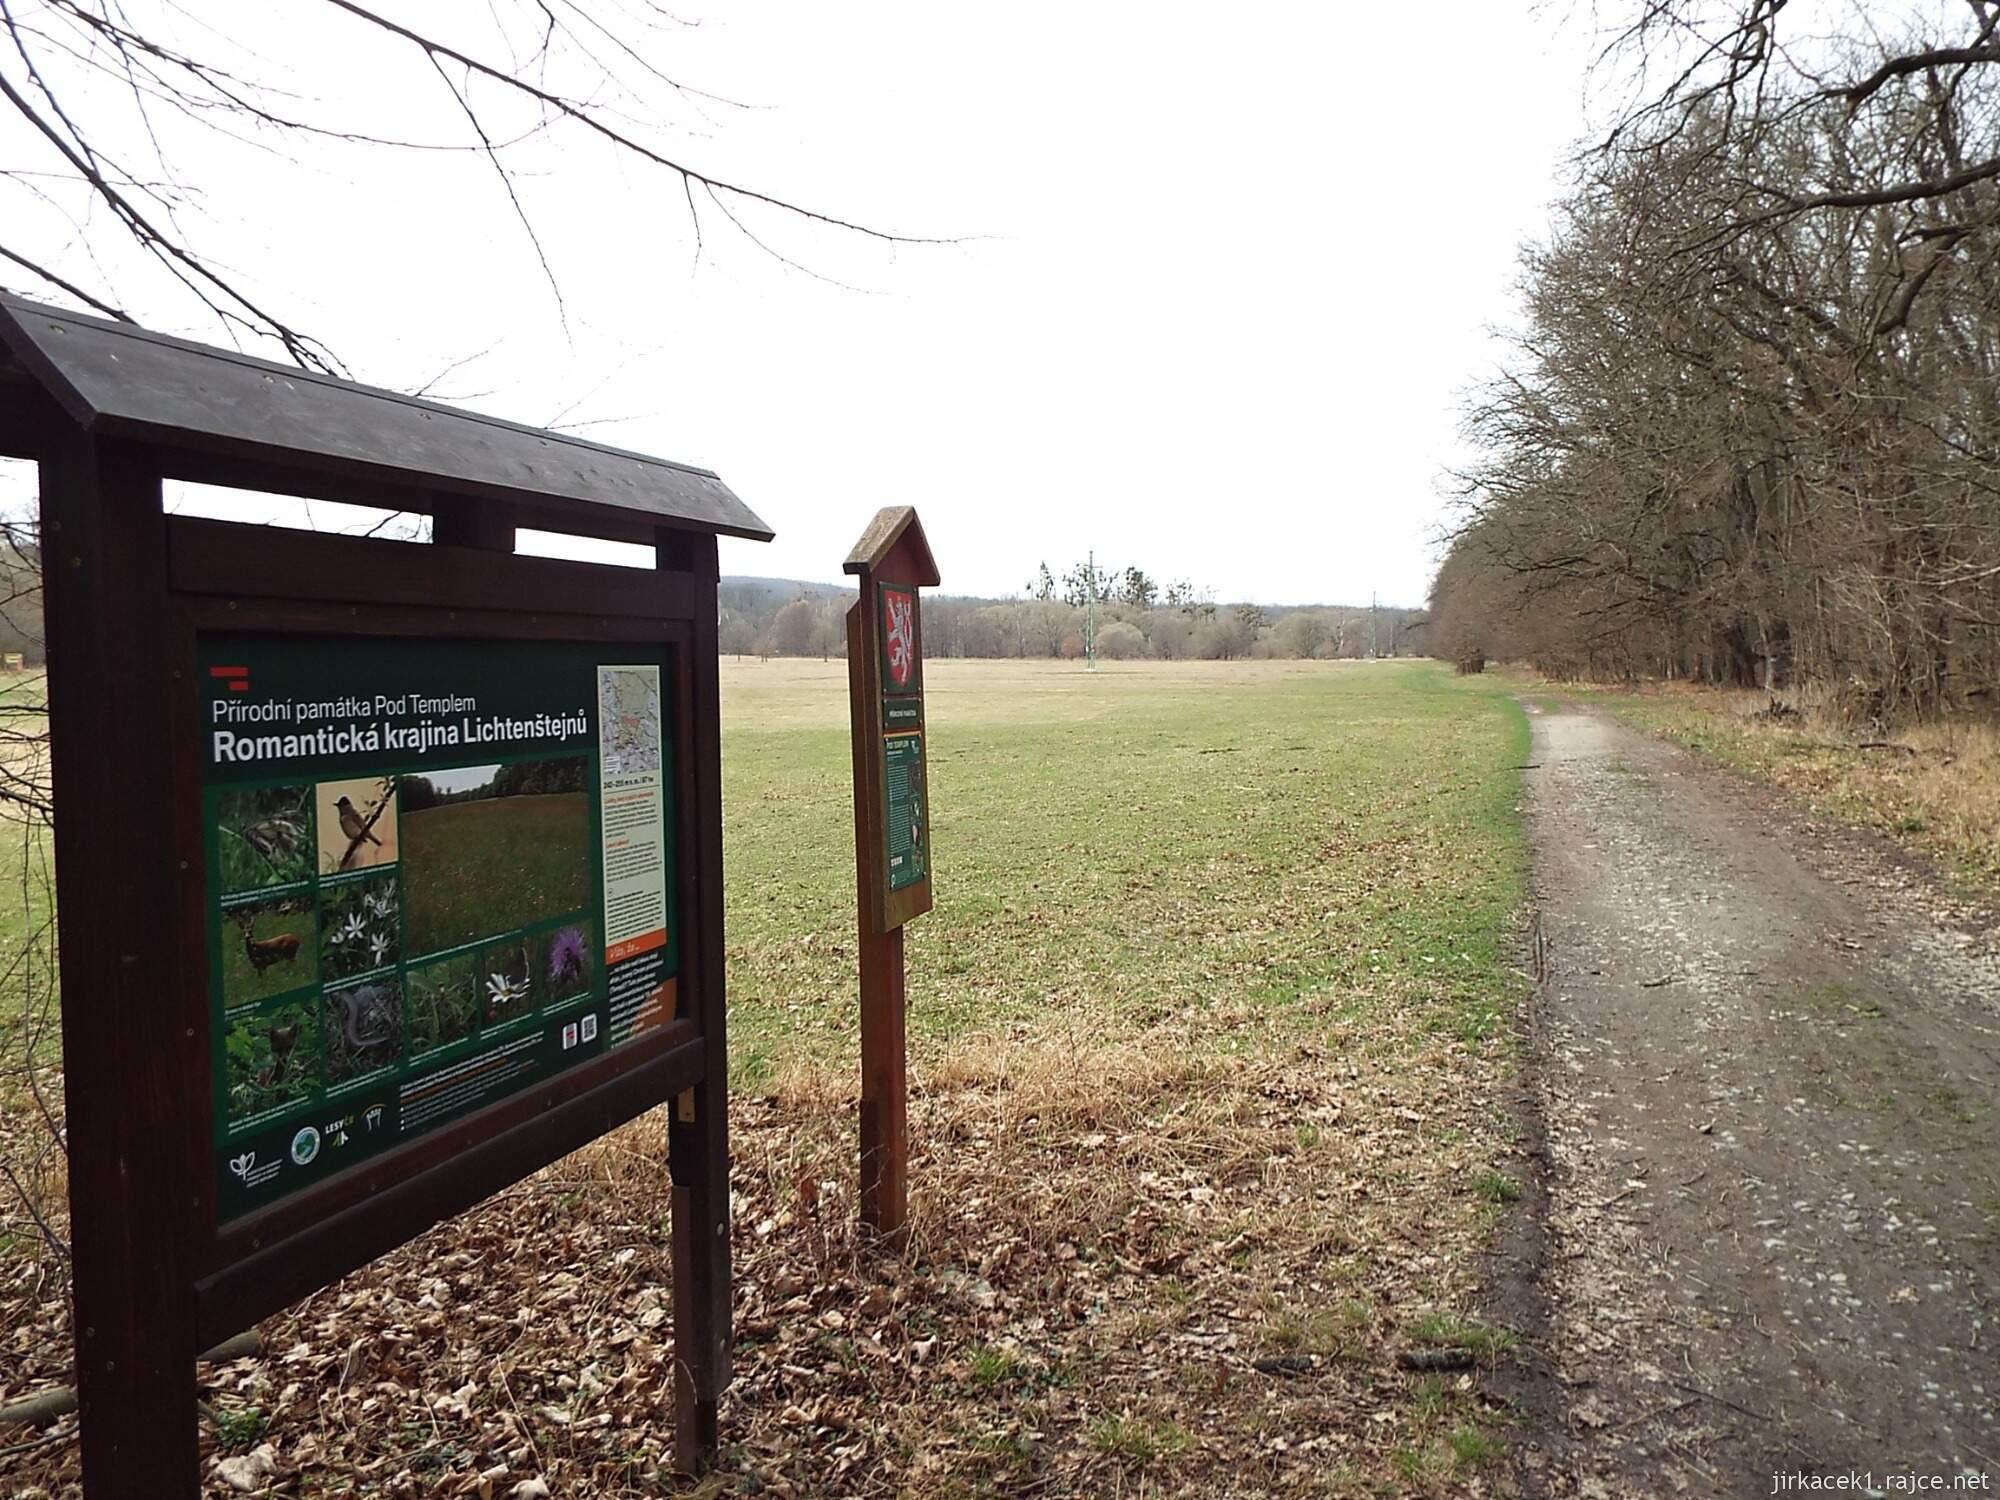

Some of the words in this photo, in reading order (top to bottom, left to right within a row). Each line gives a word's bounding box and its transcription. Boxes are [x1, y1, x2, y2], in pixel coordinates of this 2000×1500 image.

[213, 698, 292, 723] Přírodní
[296, 696, 371, 724] památka
[375, 694, 406, 716] Pod
[408, 693, 476, 717] Templem
[213, 722, 380, 763] Romantická
[384, 720, 459, 754] krajina
[463, 708, 587, 743] Lichtenštejnů
